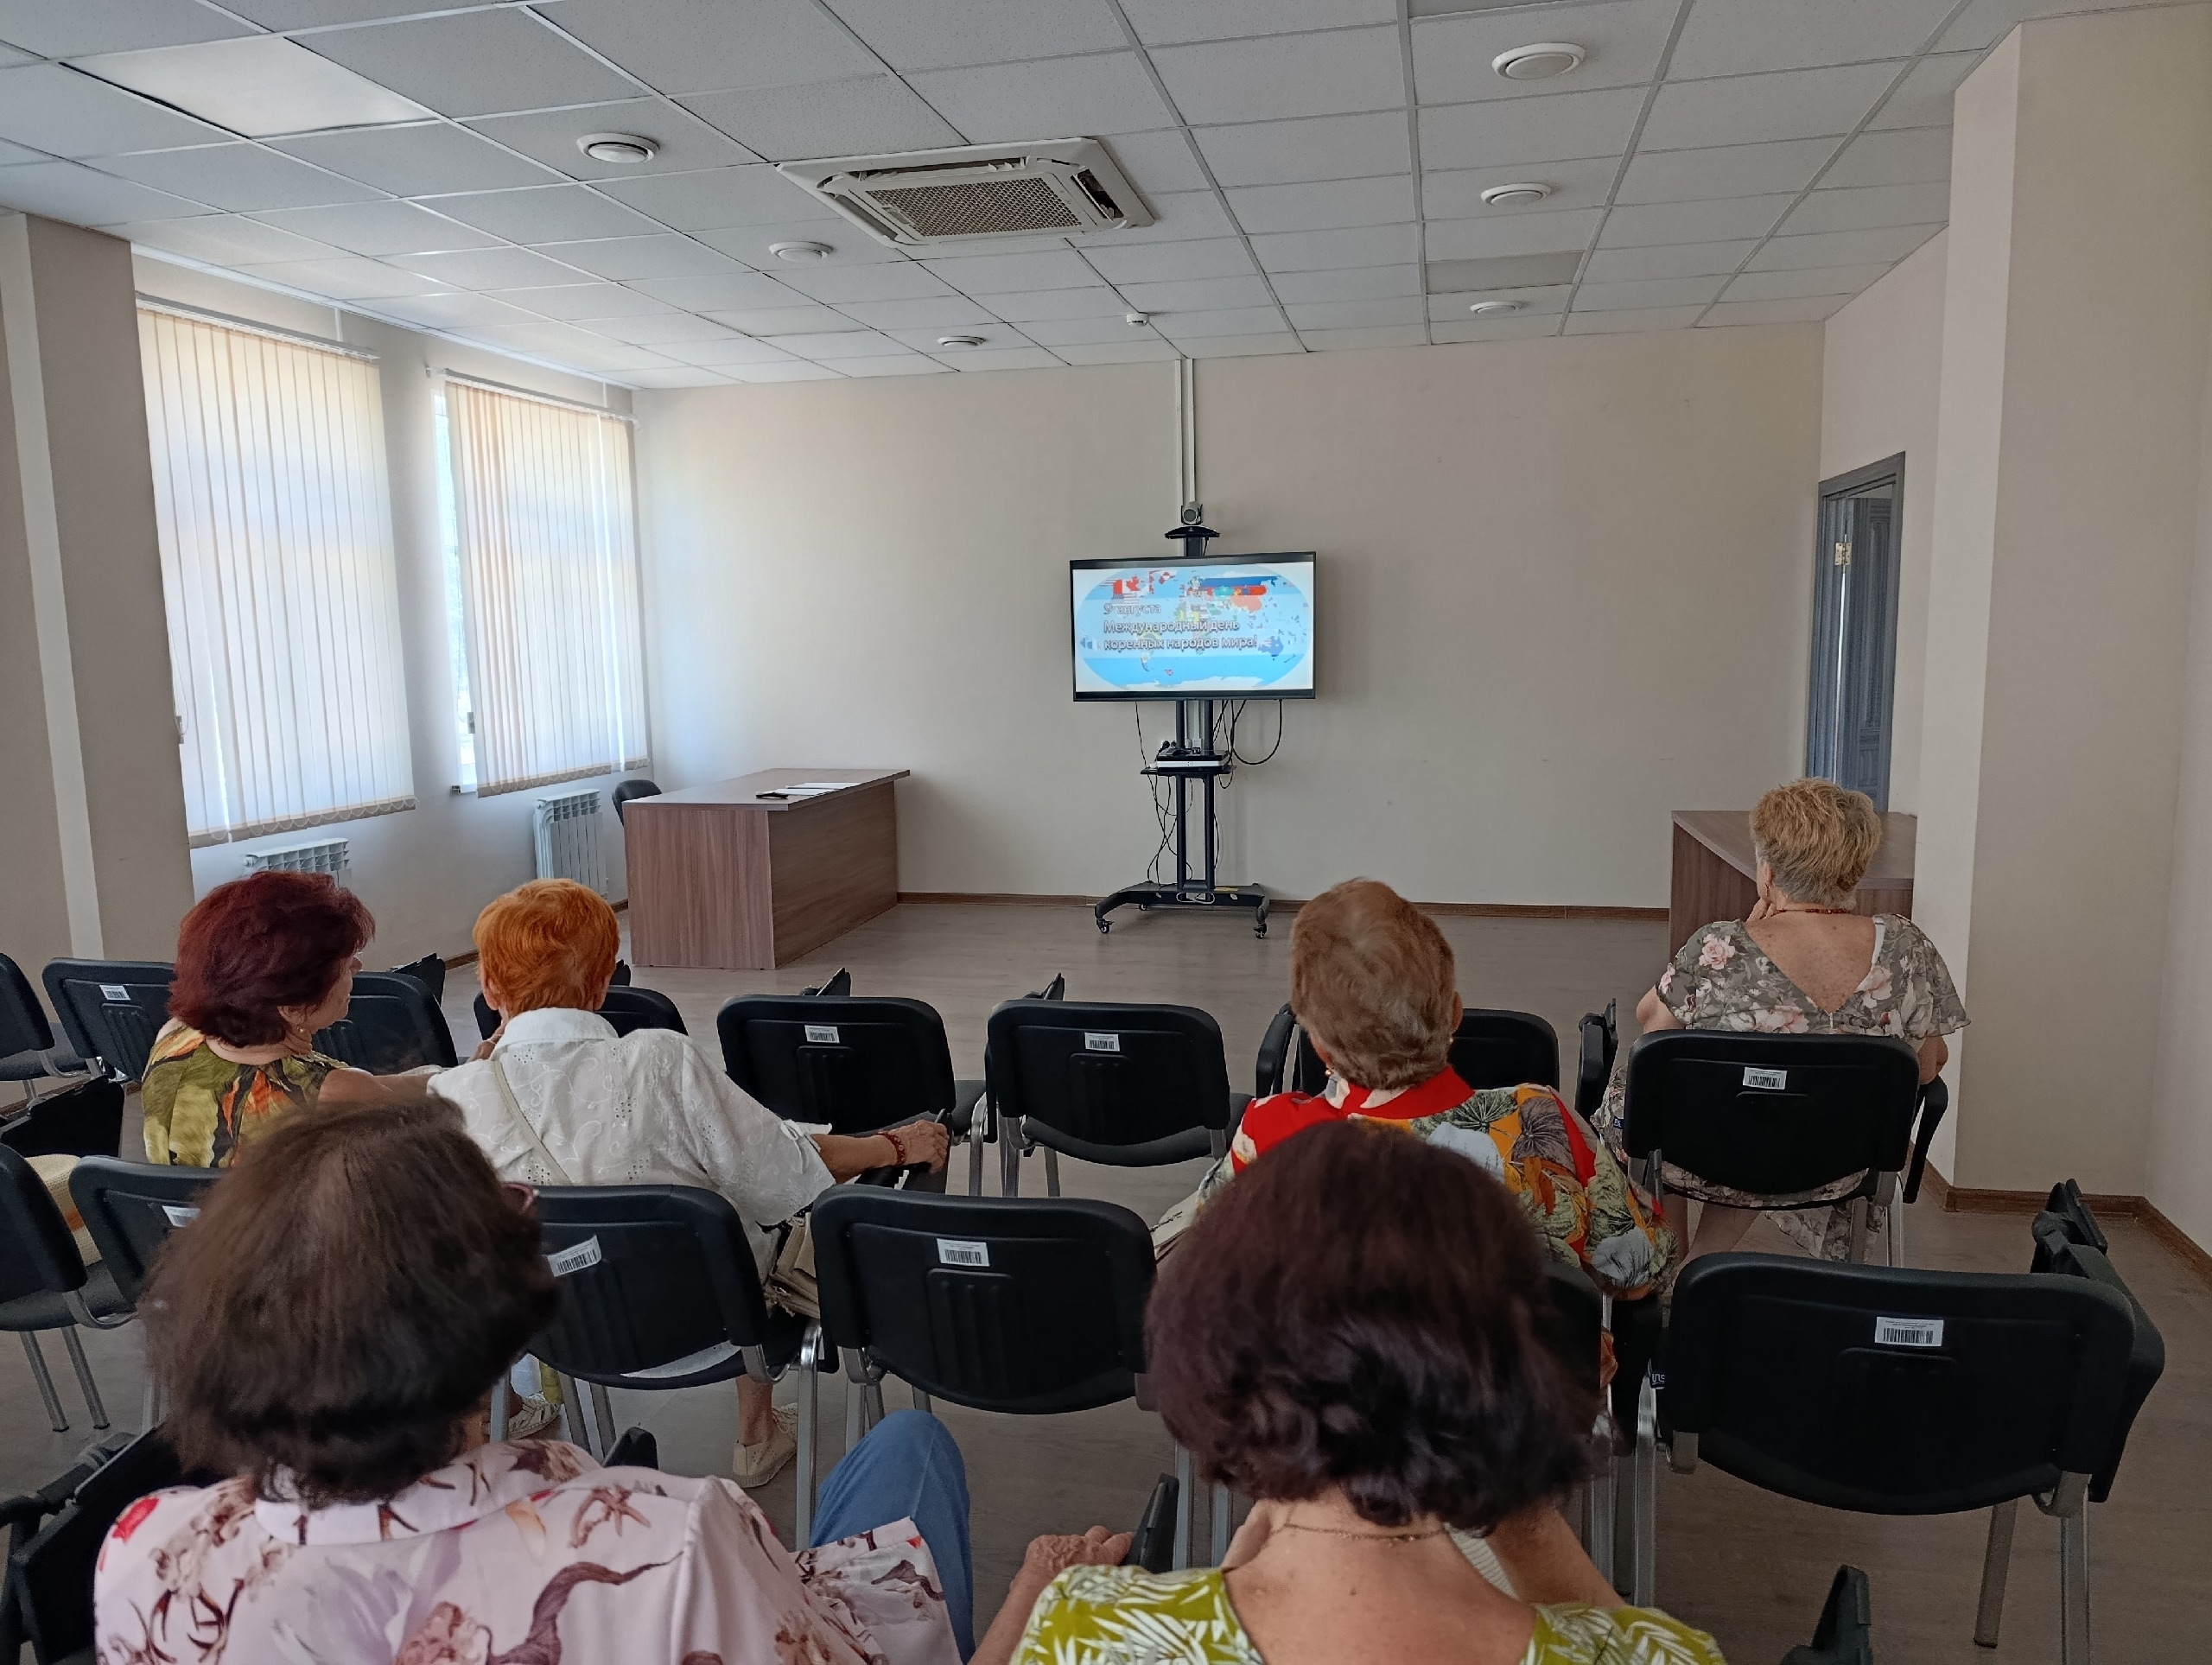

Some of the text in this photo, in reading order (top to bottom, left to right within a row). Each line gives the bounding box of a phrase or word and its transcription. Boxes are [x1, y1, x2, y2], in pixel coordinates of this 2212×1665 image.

[1103, 603, 1161, 617] 9 августа
[1103, 620, 1240, 634] Международный день
[1103, 635, 1258, 651] коренных народов мира!
